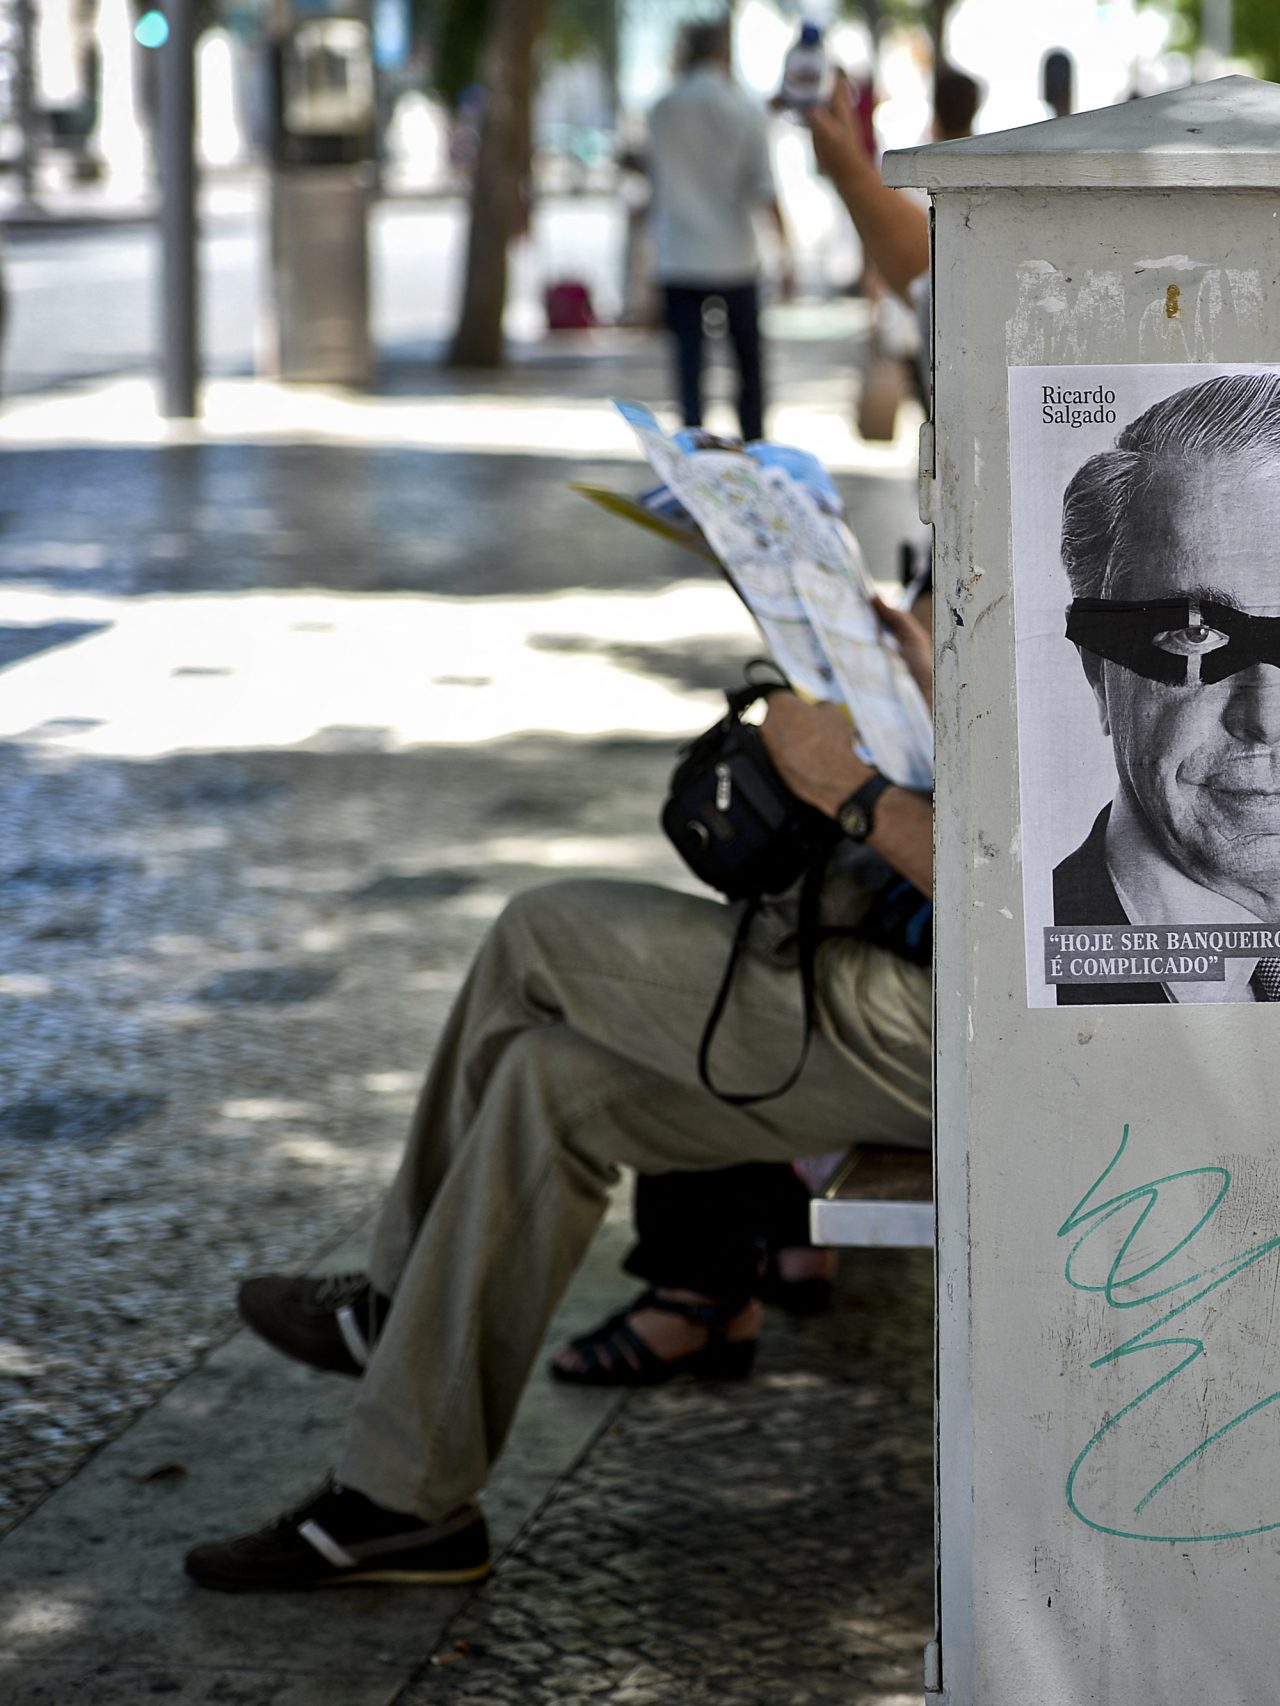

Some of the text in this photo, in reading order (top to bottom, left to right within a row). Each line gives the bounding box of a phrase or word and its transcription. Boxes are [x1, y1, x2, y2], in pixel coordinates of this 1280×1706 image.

[1041, 385, 1116, 404] Ricardo
[1042, 405, 1117, 429] Salgado
[1049, 933, 1114, 952] “HOJE
[1120, 932, 1160, 951] SER
[1050, 954, 1219, 976] É COMPLICADO”
